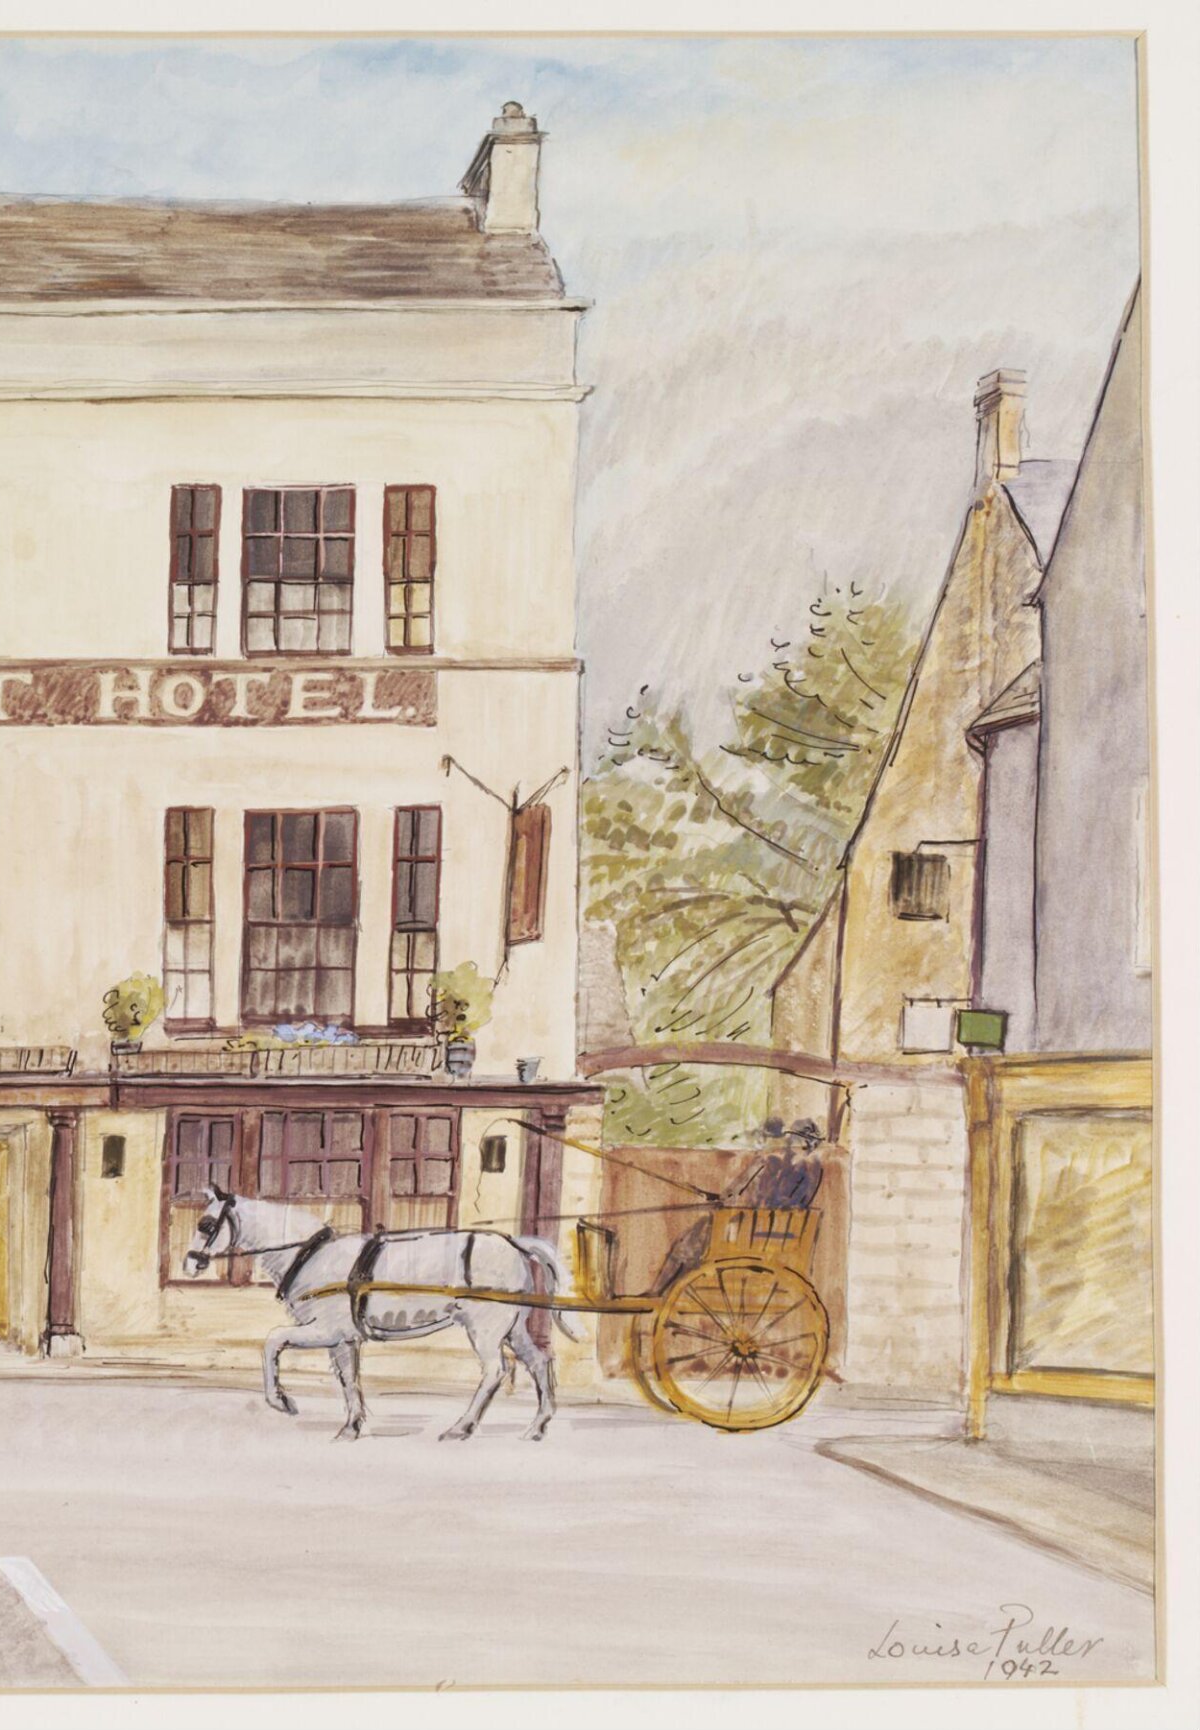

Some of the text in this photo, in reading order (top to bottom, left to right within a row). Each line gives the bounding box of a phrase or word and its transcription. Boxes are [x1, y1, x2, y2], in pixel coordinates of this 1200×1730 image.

[867, 1602, 1104, 1660] Louisa Puller
[983, 1659, 1059, 1681] 1942
